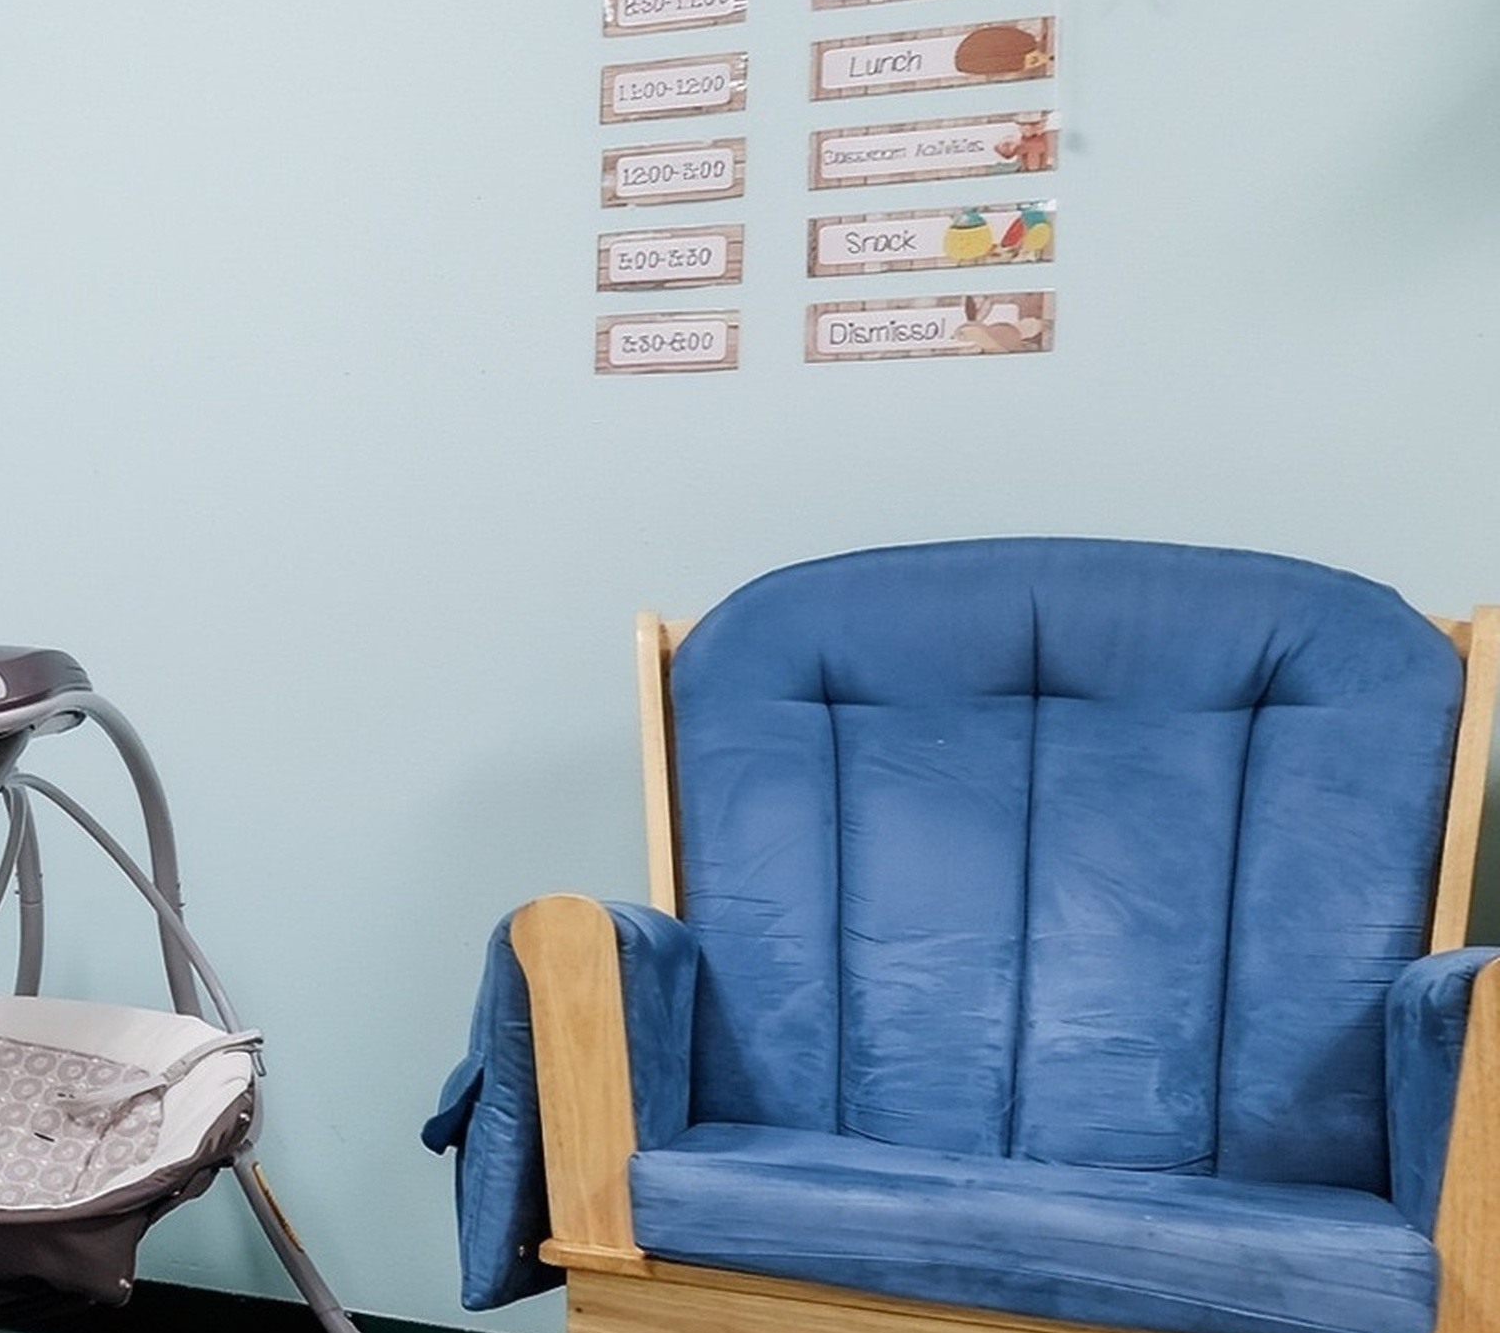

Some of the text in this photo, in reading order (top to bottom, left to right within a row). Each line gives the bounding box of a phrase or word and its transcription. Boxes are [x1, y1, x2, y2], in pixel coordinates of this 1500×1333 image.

[849, 49, 923, 78] Lunch
[846, 232, 918, 256] Snack
[829, 317, 946, 346] Dismissal
